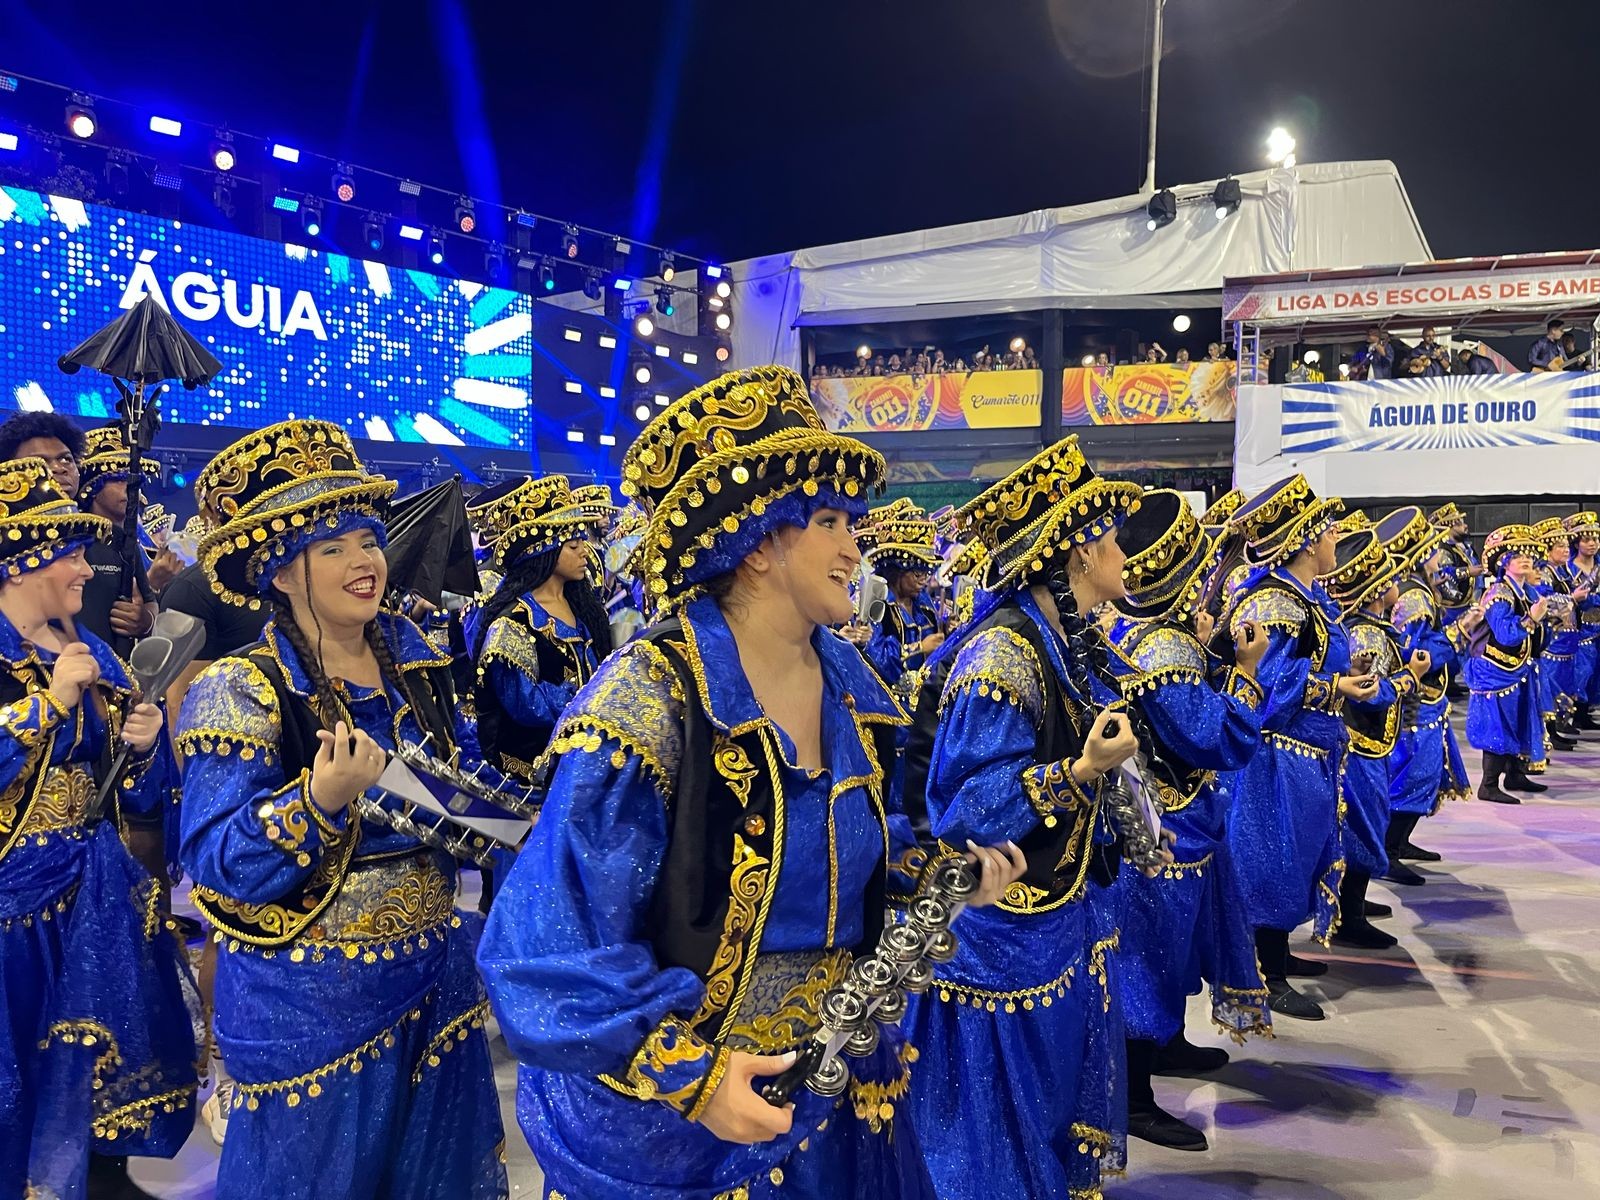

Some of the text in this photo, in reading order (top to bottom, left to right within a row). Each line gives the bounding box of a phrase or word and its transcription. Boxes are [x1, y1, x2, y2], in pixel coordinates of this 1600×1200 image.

[119, 249, 328, 341] ÁGUIA
[1277, 294, 1327, 311] LIGA
[1334, 291, 1379, 308] DAS
[1386, 284, 1492, 305] ESCOLAS
[1500, 282, 1530, 298] DE
[870, 396, 906, 426] 011
[970, 393, 1040, 409] Camarote 011
[1123, 387, 1161, 417] 011
[1369, 400, 1537, 428] ÁGUIA DE OURO
